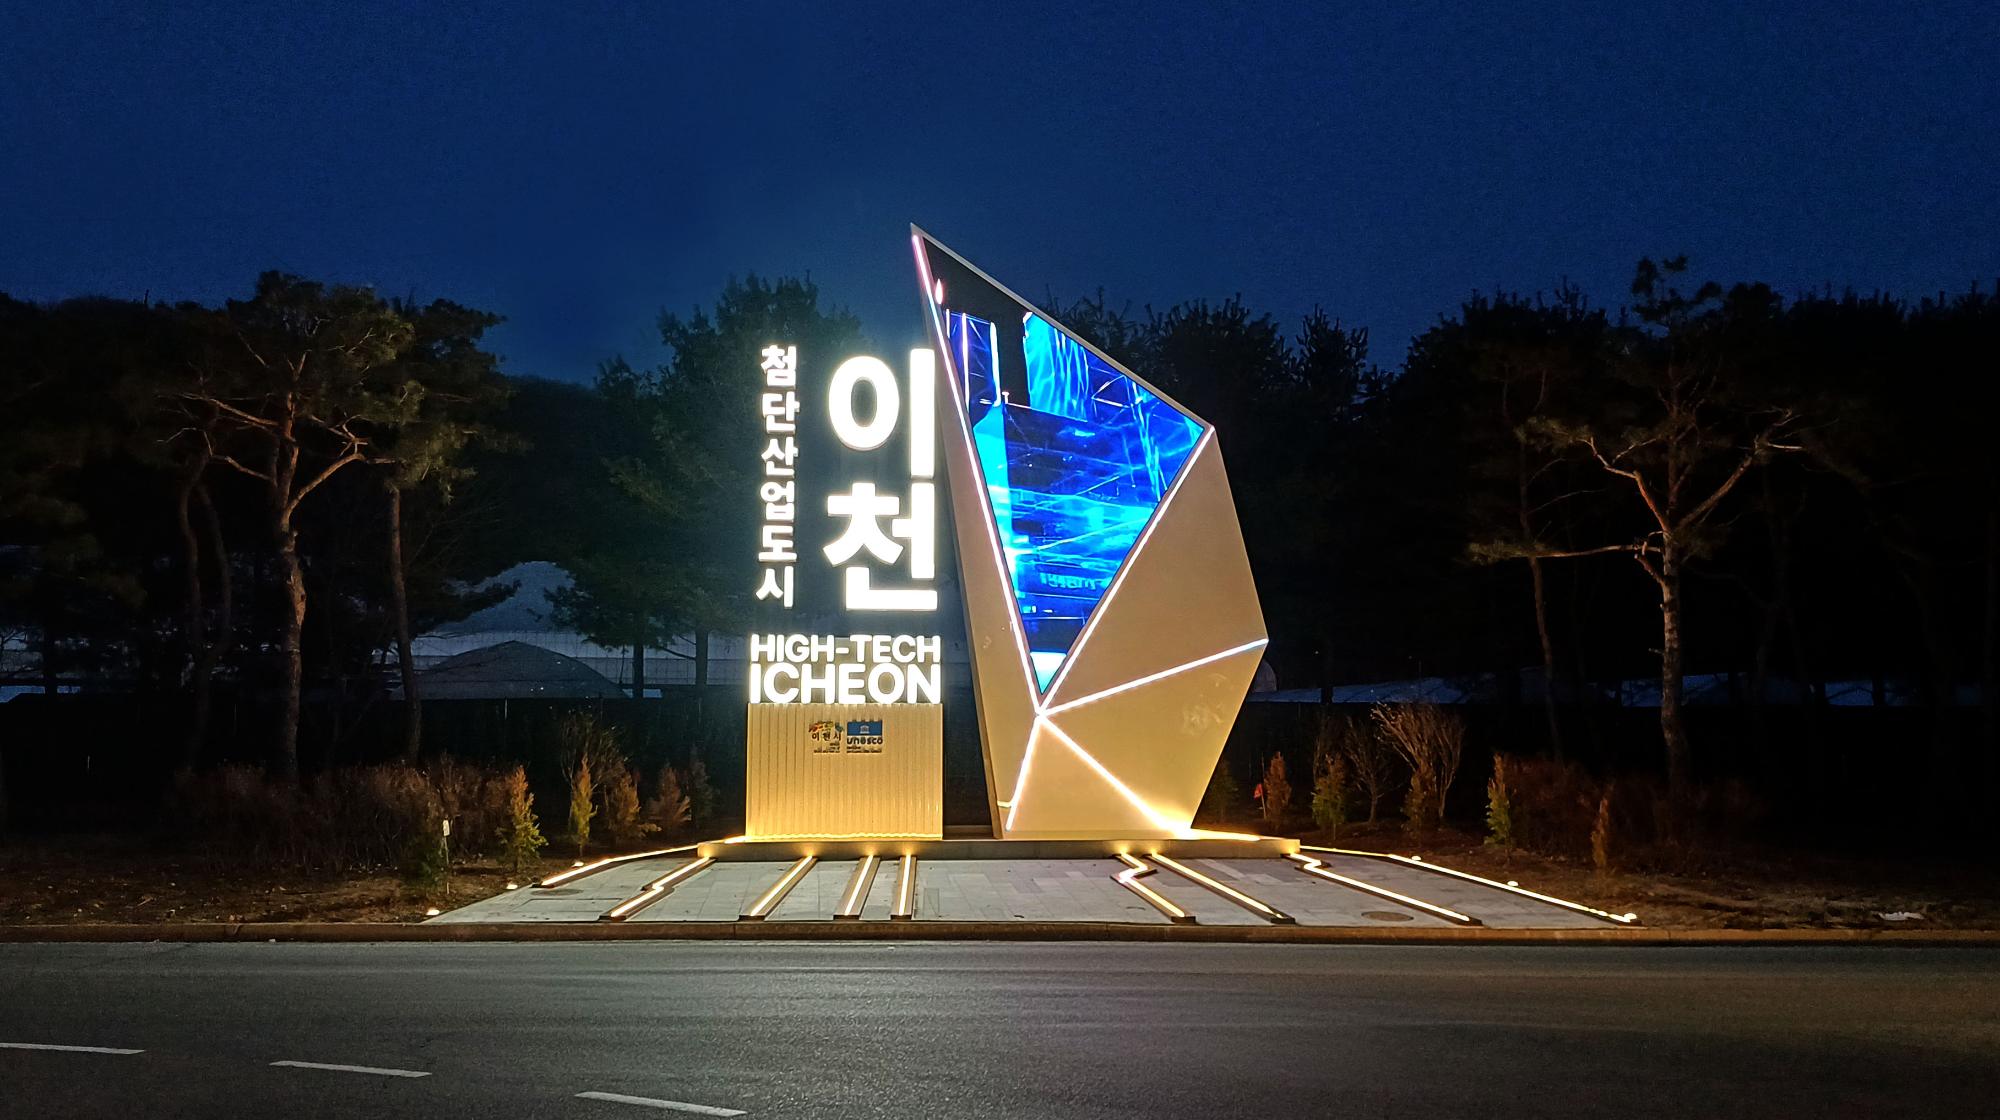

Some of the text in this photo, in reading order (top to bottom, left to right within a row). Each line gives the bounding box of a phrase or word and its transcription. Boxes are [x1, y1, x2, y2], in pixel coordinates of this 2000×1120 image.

[756, 345, 800, 608] 첨단산업도시
[823, 349, 938, 611] 이천
[750, 634, 941, 662] HIGH-TECH
[750, 663, 941, 704] ICHEON
